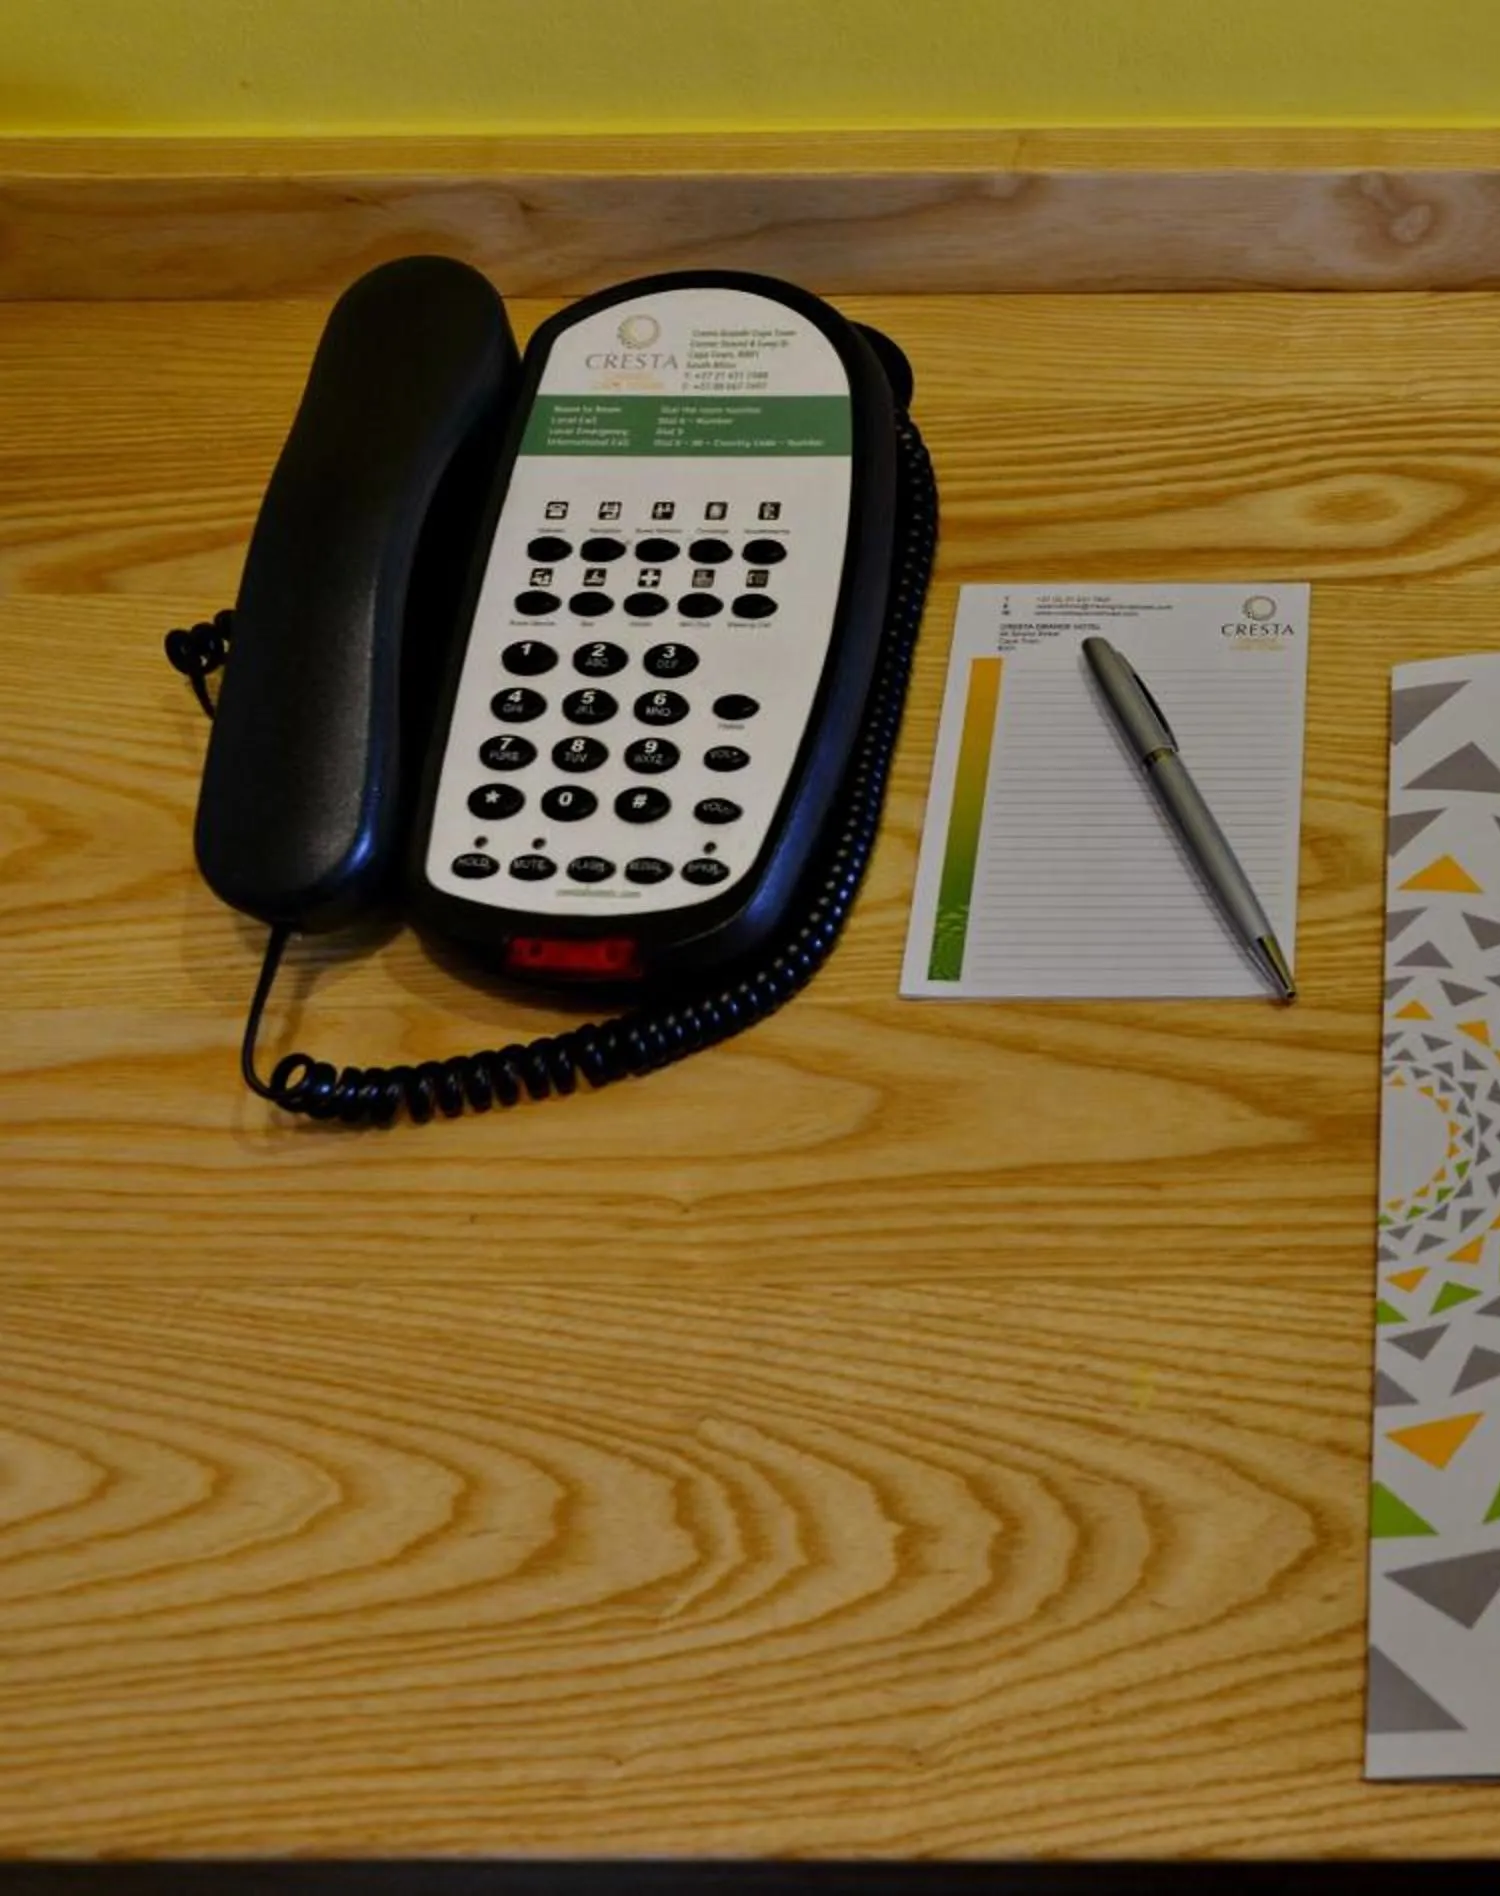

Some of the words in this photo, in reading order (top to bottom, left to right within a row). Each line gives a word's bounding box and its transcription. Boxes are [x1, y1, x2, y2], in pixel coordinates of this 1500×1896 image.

[585, 352, 679, 370] CRESTA
[1221, 623, 1294, 637] CRESTA
[521, 642, 532, 656] 1
[591, 643, 606, 657] 2
[661, 645, 676, 659] 3
[584, 657, 609, 668] ABC
[507, 689, 523, 703] 4
[580, 690, 596, 704] 5
[652, 692, 667, 705] 6
[645, 705, 671, 717] MNO
[499, 737, 513, 751] 7
[570, 739, 586, 752] 8
[644, 740, 658, 753] 9
[564, 752, 588, 763] TUV
[558, 791, 574, 807] 0
[632, 793, 648, 809] #
